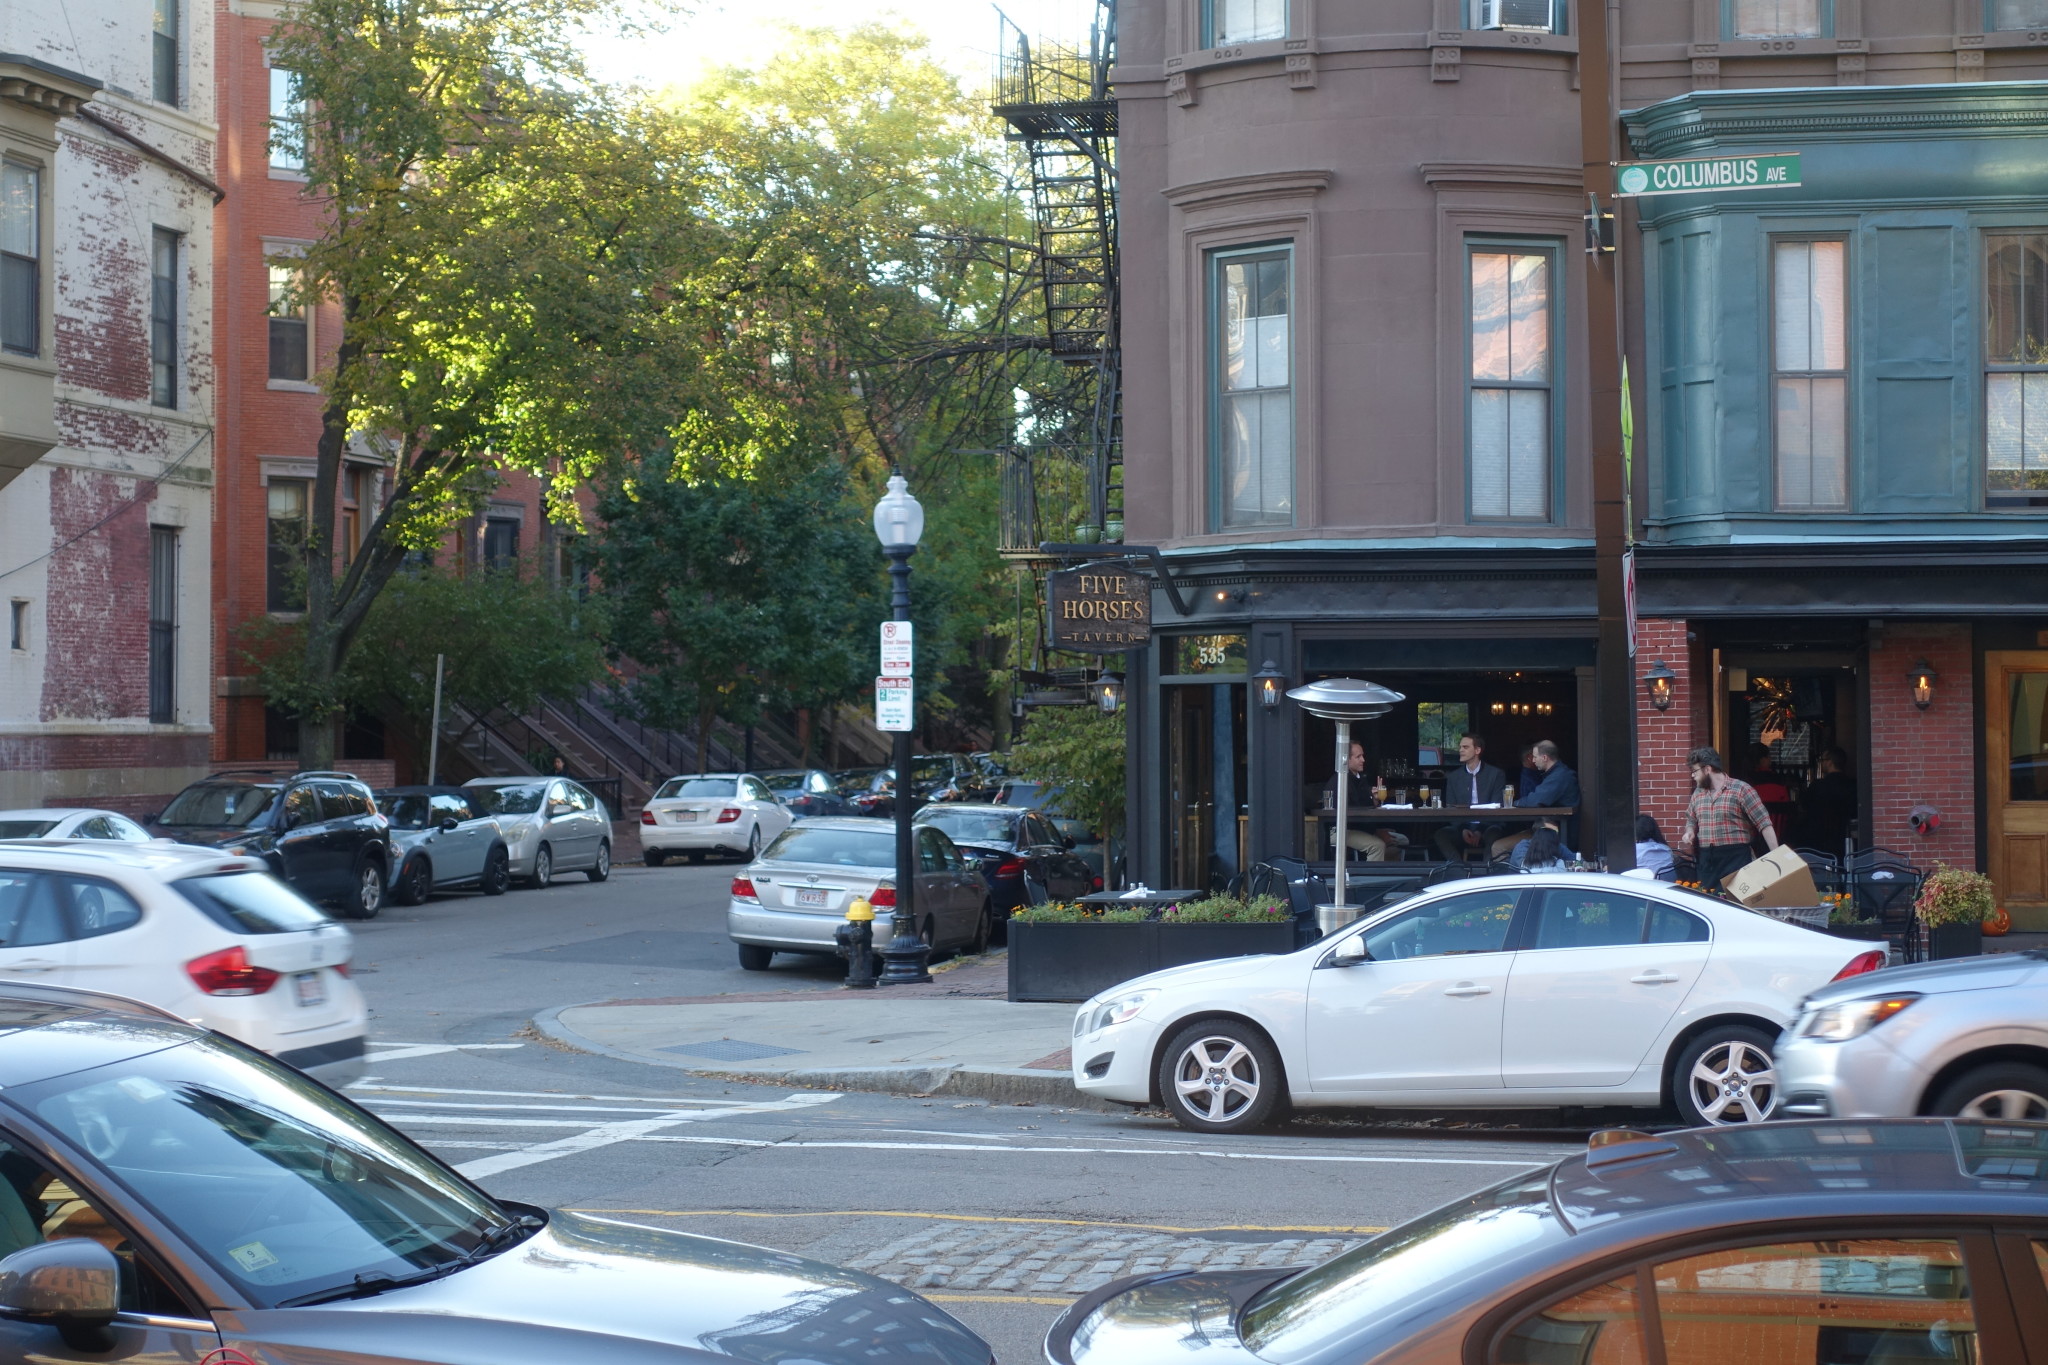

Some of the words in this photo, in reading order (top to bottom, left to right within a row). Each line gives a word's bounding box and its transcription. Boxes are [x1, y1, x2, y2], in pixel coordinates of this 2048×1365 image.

[1653, 159, 1758, 189] COLUMBUS
[1766, 166, 1787, 182] AVE
[1079, 575, 1127, 595] FIVE
[1063, 600, 1144, 623] HORSES
[1071, 632, 1135, 643] TAVERN
[1199, 646, 1226, 665] 535
[878, 679, 896, 688] South
[898, 679, 911, 688] End
